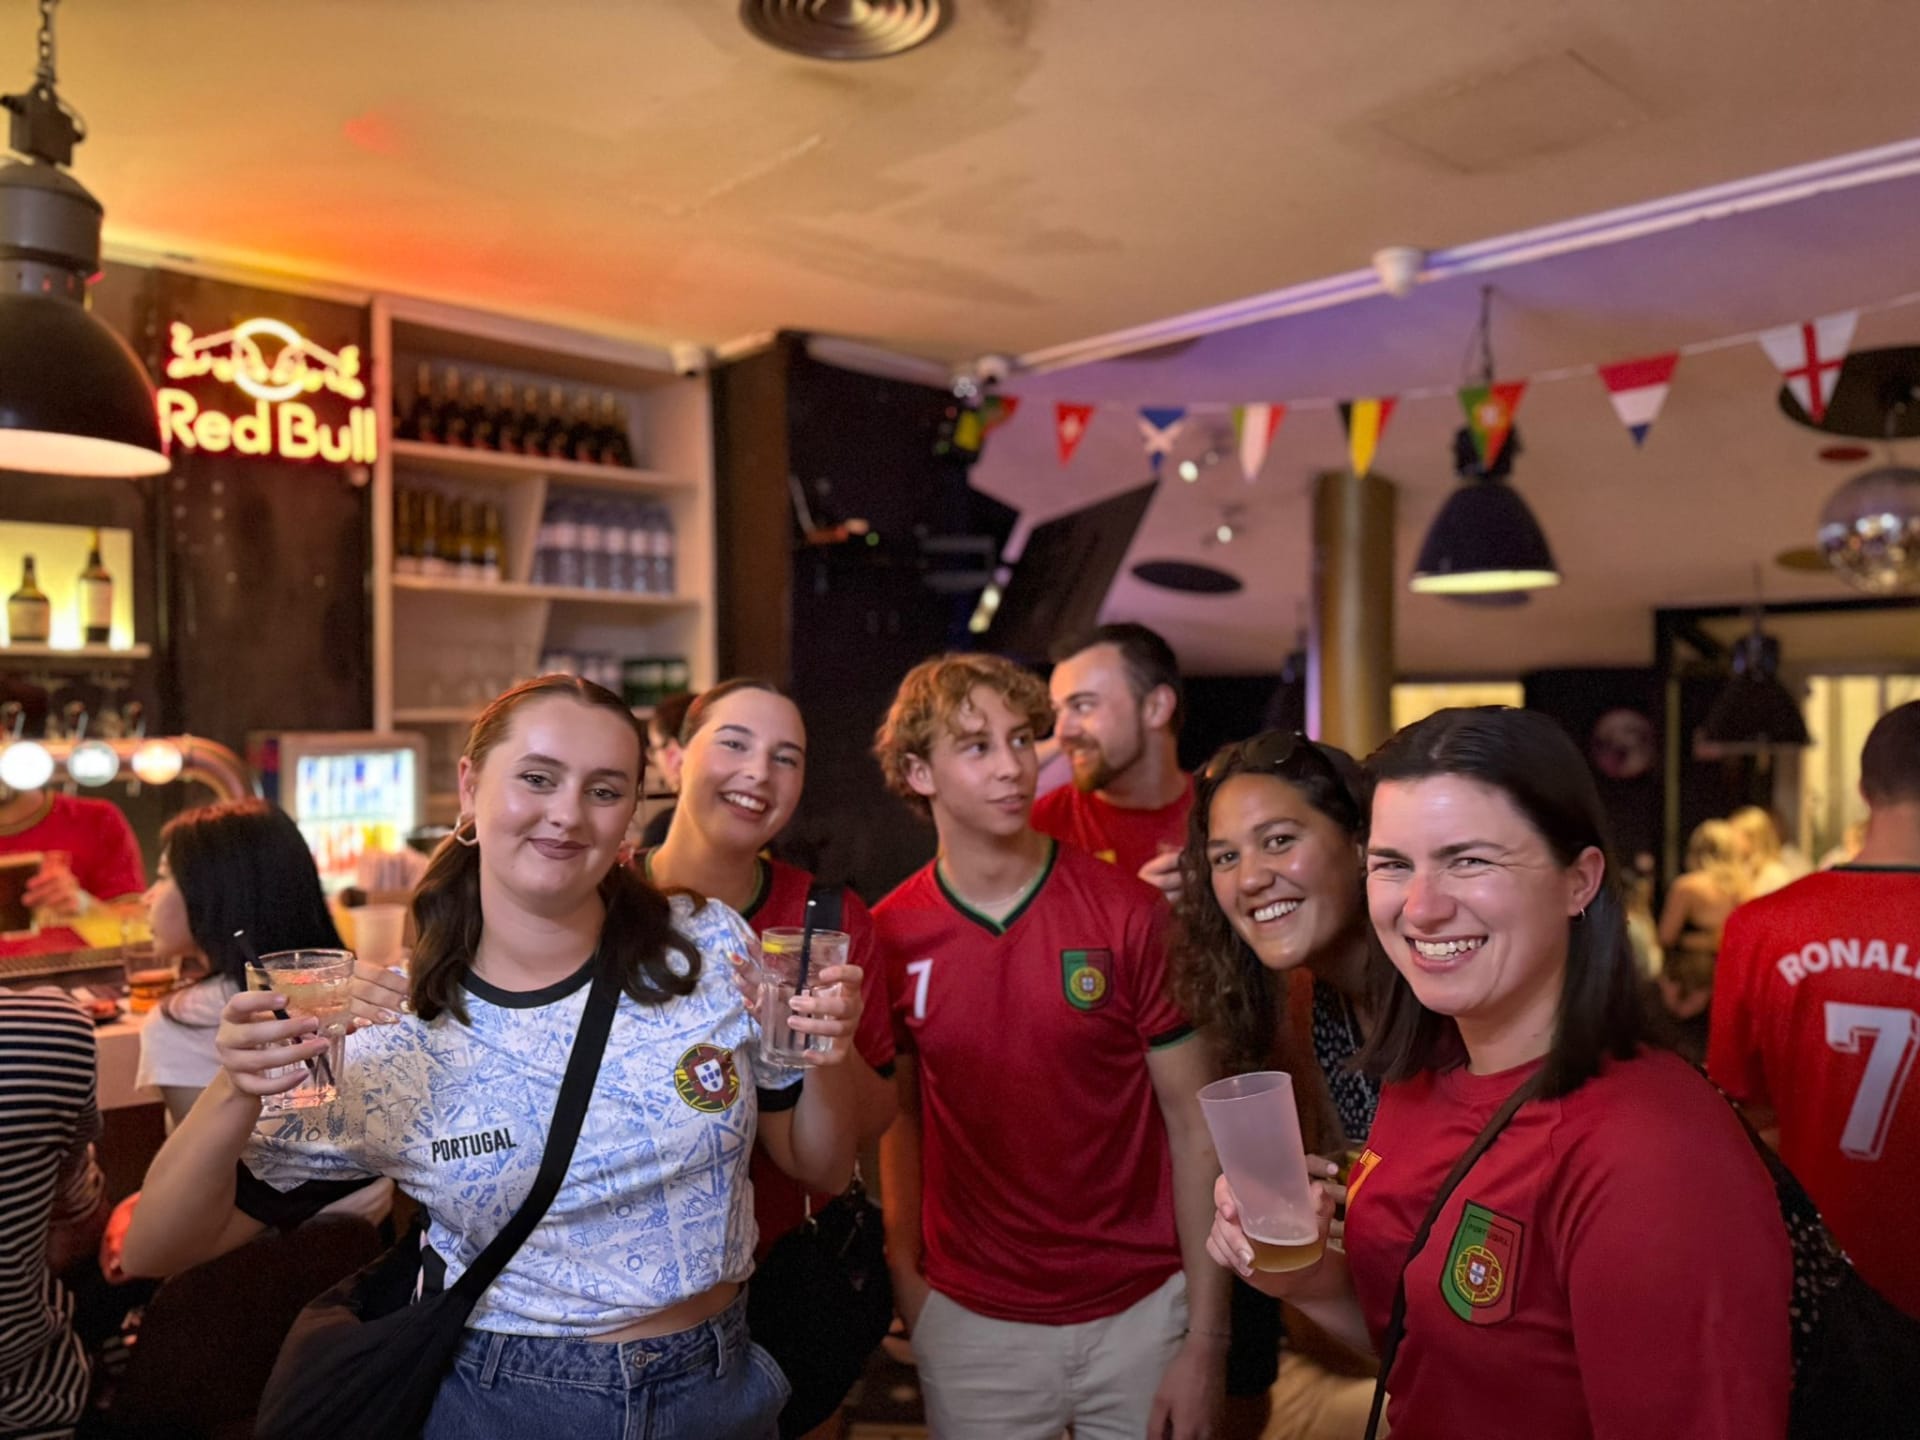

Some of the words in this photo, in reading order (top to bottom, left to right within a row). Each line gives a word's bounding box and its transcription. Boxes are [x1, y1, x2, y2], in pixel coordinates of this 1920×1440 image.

[157, 388, 272, 454] Red
[278, 401, 377, 464] Bull
[1777, 937, 1920, 986] RONAL
[1824, 1001, 1920, 1161] 7
[431, 1127, 517, 1163] PORTUGAL
